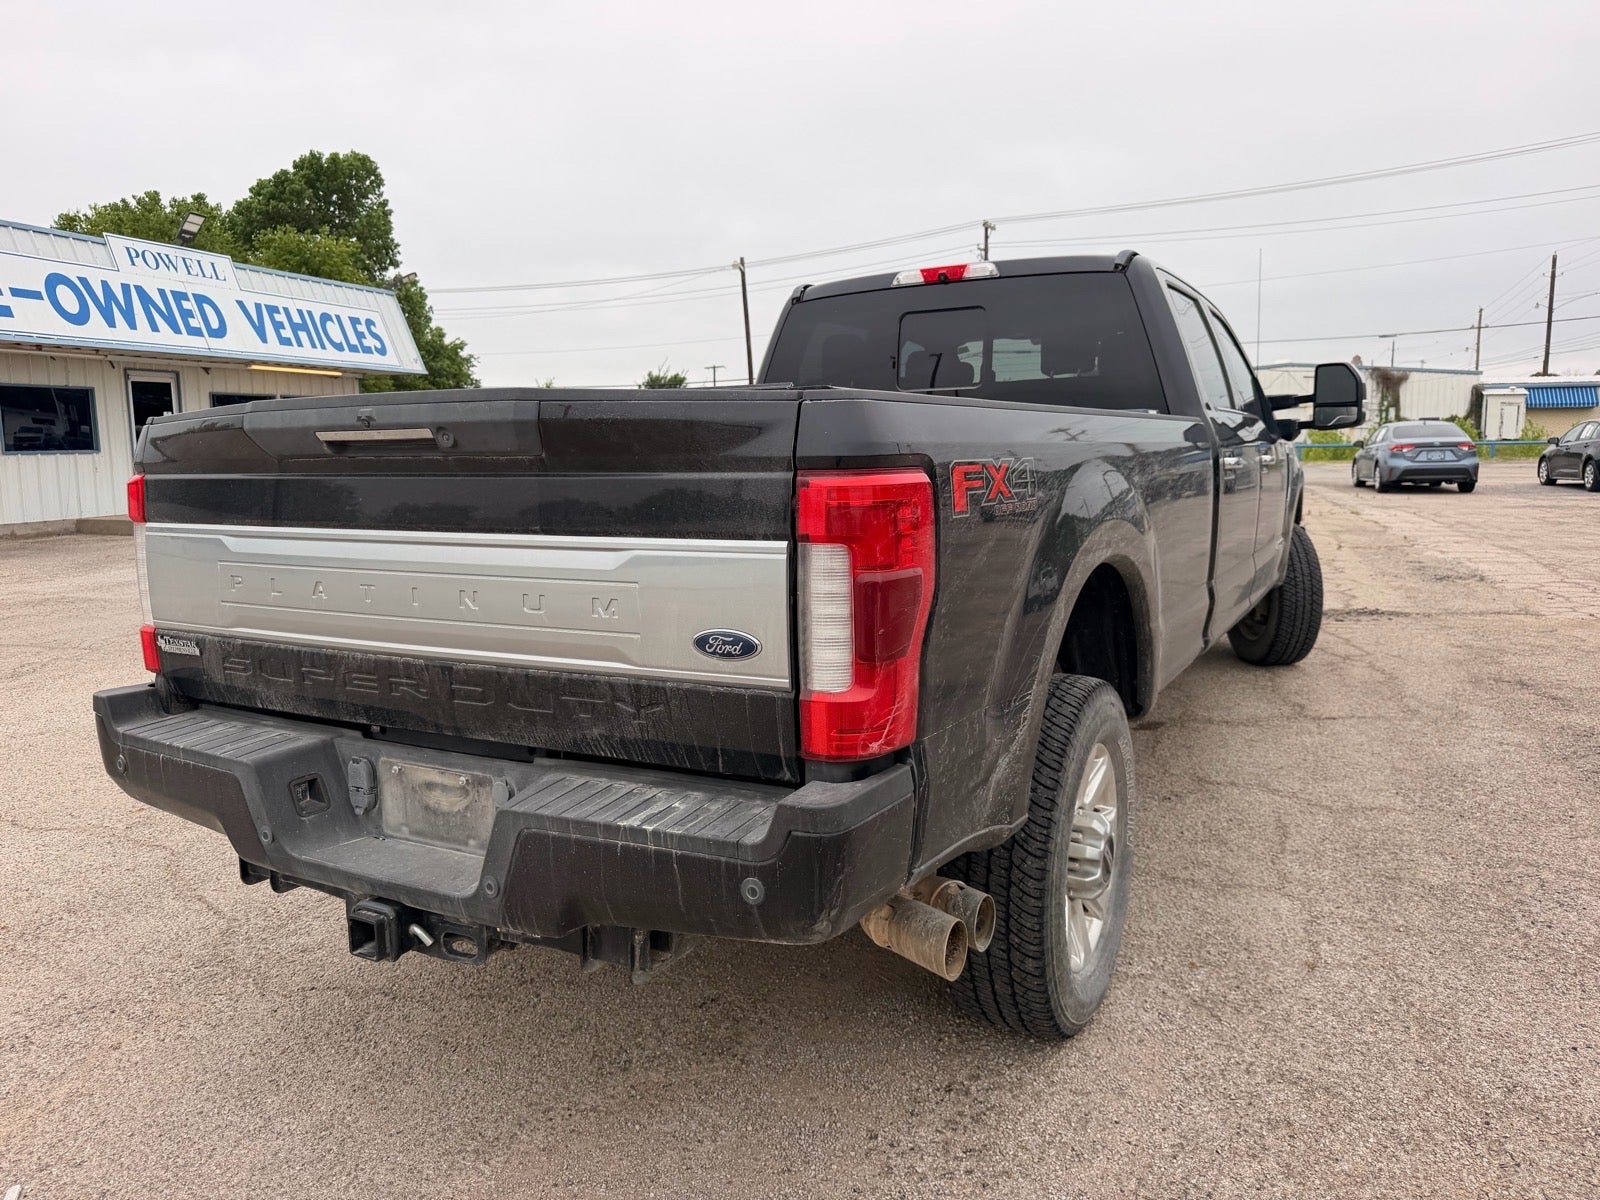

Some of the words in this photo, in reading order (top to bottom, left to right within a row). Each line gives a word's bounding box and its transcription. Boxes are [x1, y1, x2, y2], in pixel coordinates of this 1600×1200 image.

[124, 245, 227, 282] POWELL
[0, 272, 228, 340] -OWNED
[236, 299, 388, 357] VEHICLES
[950, 457, 1037, 518] FX4
[230, 574, 619, 619] PLATINUM
[705, 635, 744, 655] Ford
[222, 655, 430, 699] SUPER
[449, 680, 666, 724] DUTY
